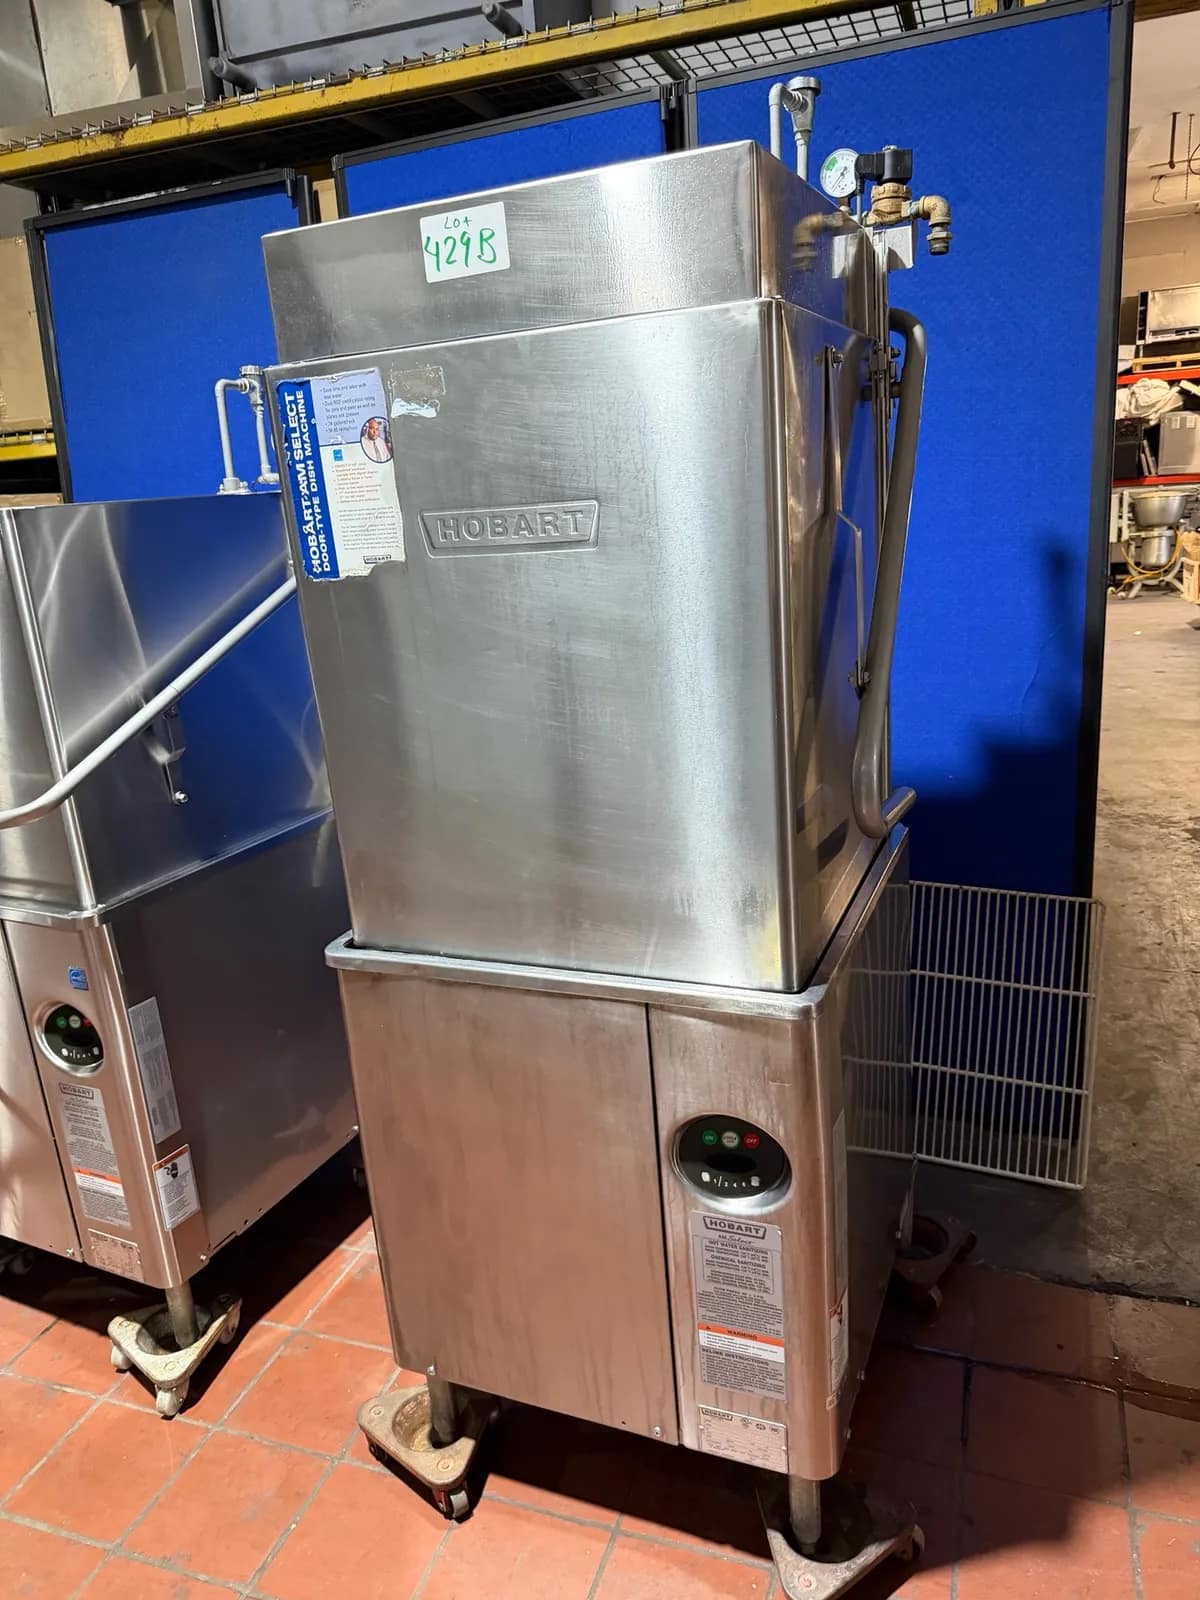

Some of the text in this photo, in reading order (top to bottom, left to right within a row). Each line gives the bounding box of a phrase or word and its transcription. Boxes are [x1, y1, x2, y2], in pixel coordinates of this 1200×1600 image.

[285, 392, 303, 460] SELECT
[297, 390, 331, 571] DOOR-TYPE DISH MACHINE
[437, 511, 584, 542] HOBART
[709, 1219, 761, 1235] HOBART
